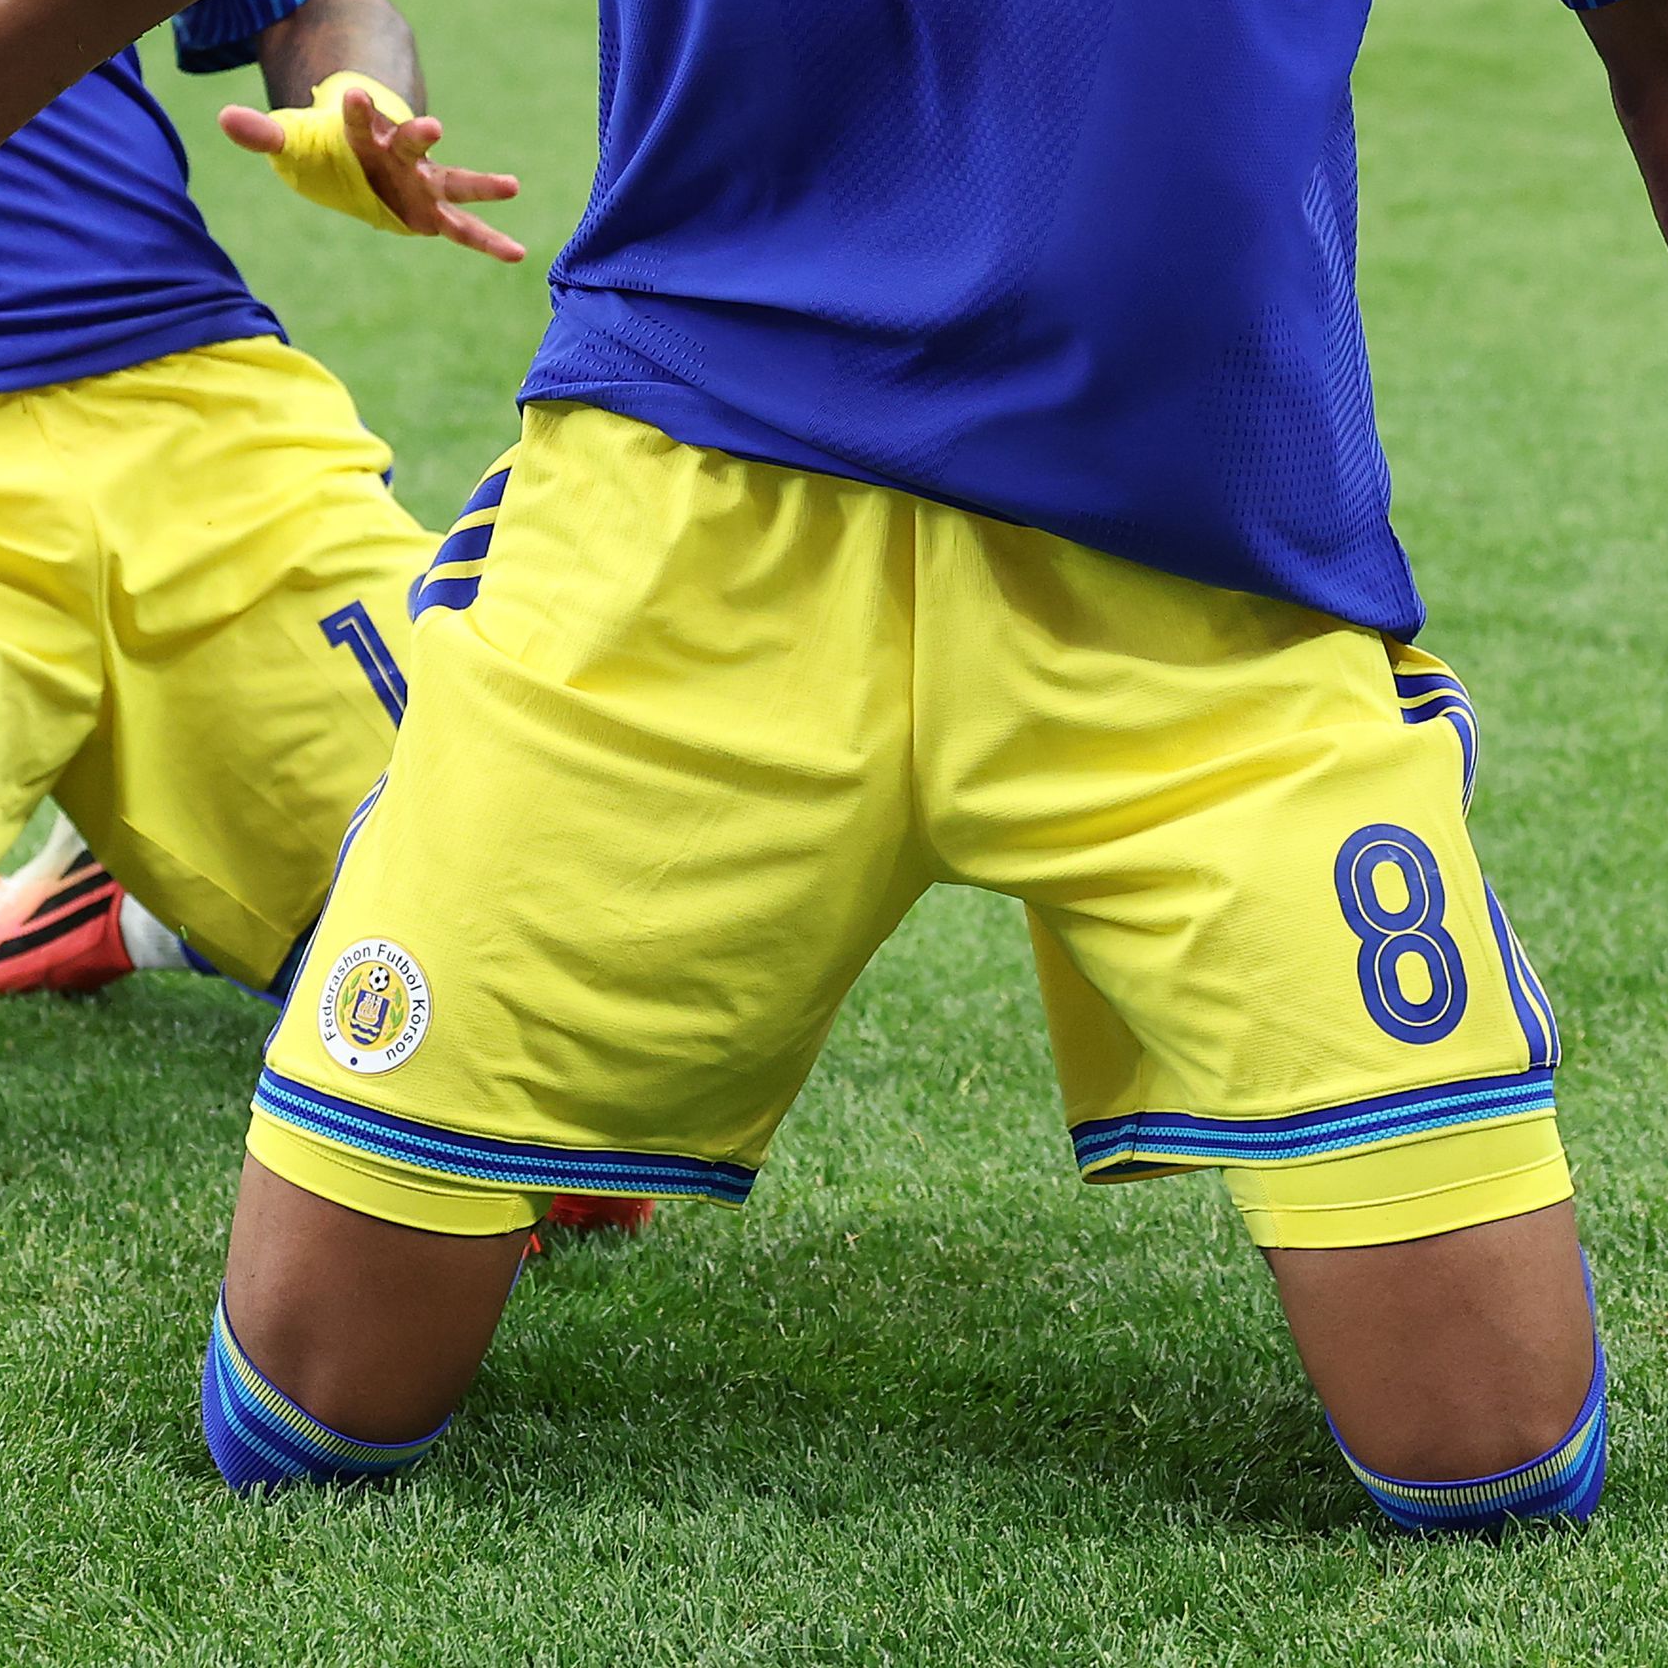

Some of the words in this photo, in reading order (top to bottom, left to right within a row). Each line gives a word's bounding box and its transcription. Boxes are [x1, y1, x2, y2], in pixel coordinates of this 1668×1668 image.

[377, 943, 422, 992] Futbòl
[1334, 823, 1468, 1045] 8
[321, 945, 371, 1042] Federashon
[386, 999, 426, 1061] Kòrsou
